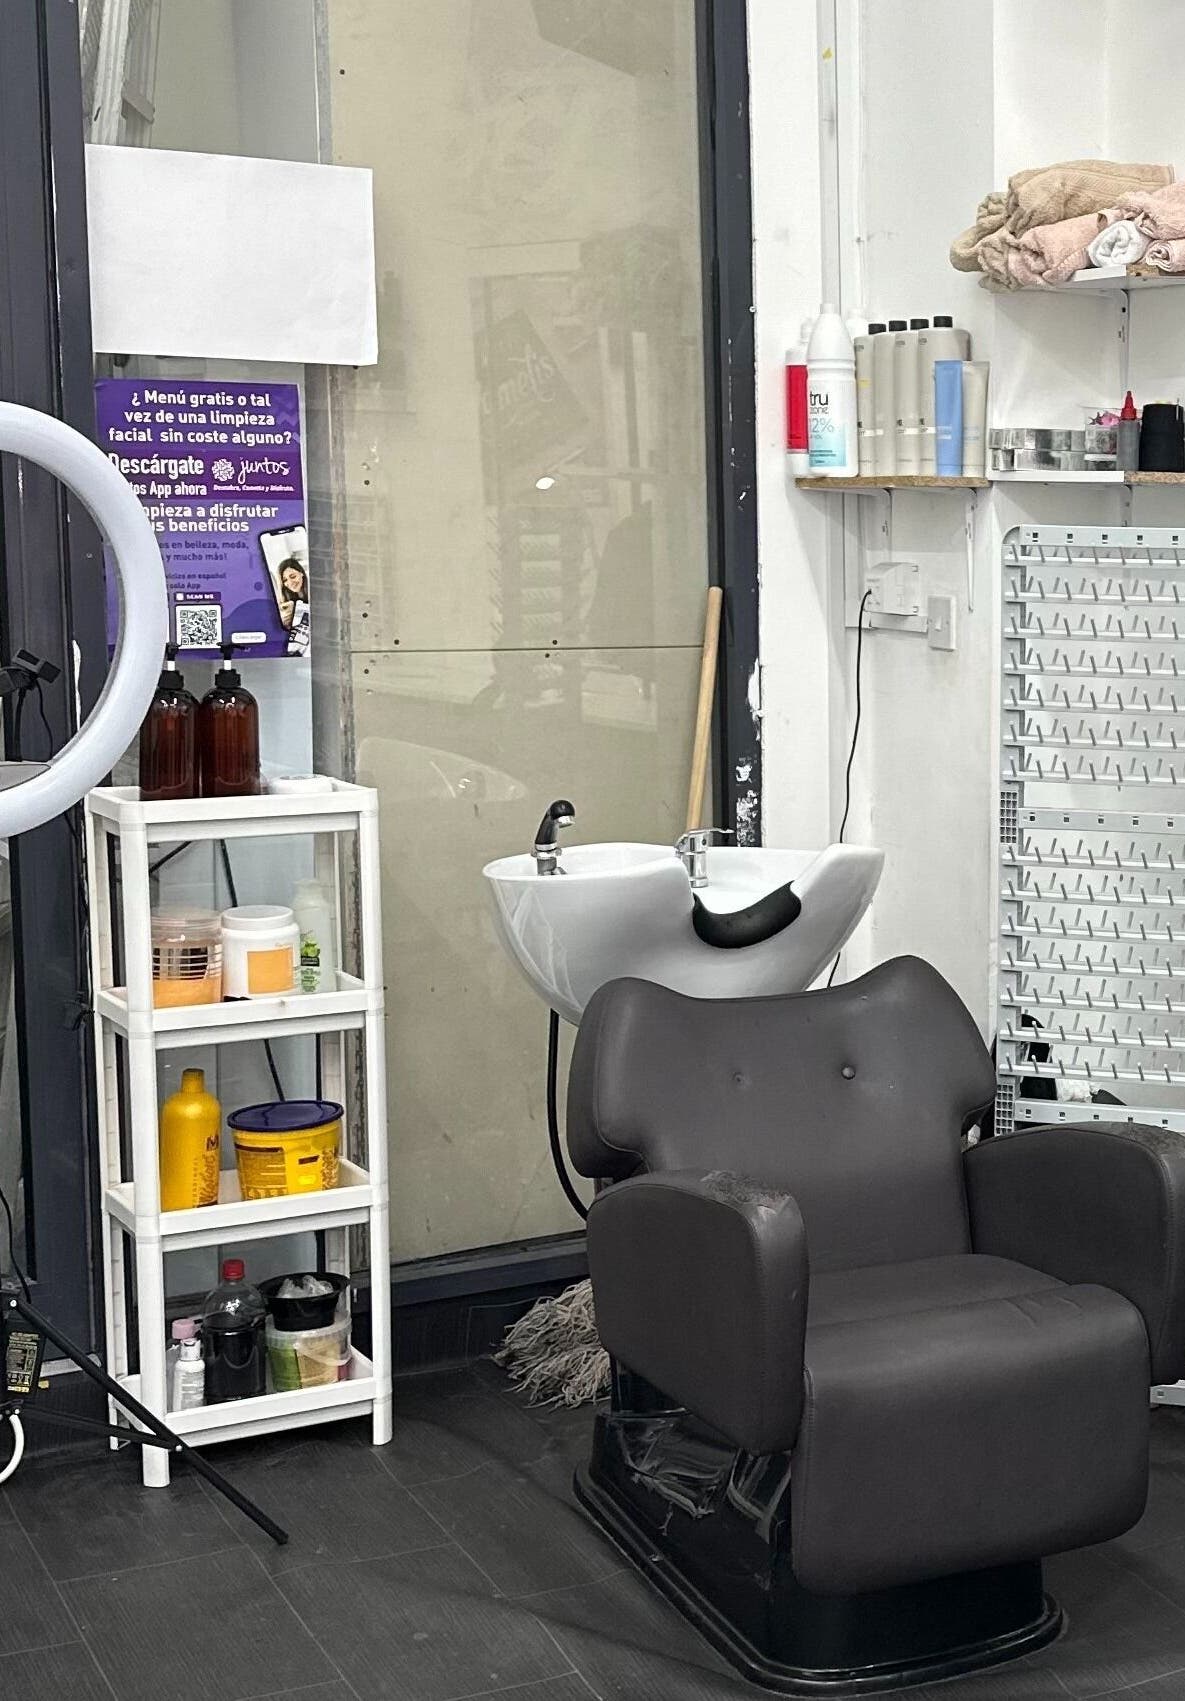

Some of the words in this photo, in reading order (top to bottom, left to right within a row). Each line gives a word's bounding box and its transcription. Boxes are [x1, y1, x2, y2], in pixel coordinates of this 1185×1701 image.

[144, 389, 186, 405] Menú
[190, 391, 234, 408] gratis
[238, 395, 247, 406] o
[250, 393, 271, 407] tal
[810, 391, 829, 406] tru
[124, 411, 152, 423] vez
[155, 410, 175, 423] de
[178, 412, 206, 424] una
[210, 410, 275, 427] limpieza
[109, 428, 152, 442] facial
[160, 429, 183, 443] sin
[187, 430, 228, 443] coste
[232, 431, 292, 447] alguno?
[238, 456, 291, 485] juntos
[130, 482, 147, 495] tos
[149, 481, 172, 500] App
[175, 481, 207, 496] ahora
[196, 506, 206, 517] a
[210, 502, 279, 518] disfrutar
[169, 518, 249, 532] beneficios
